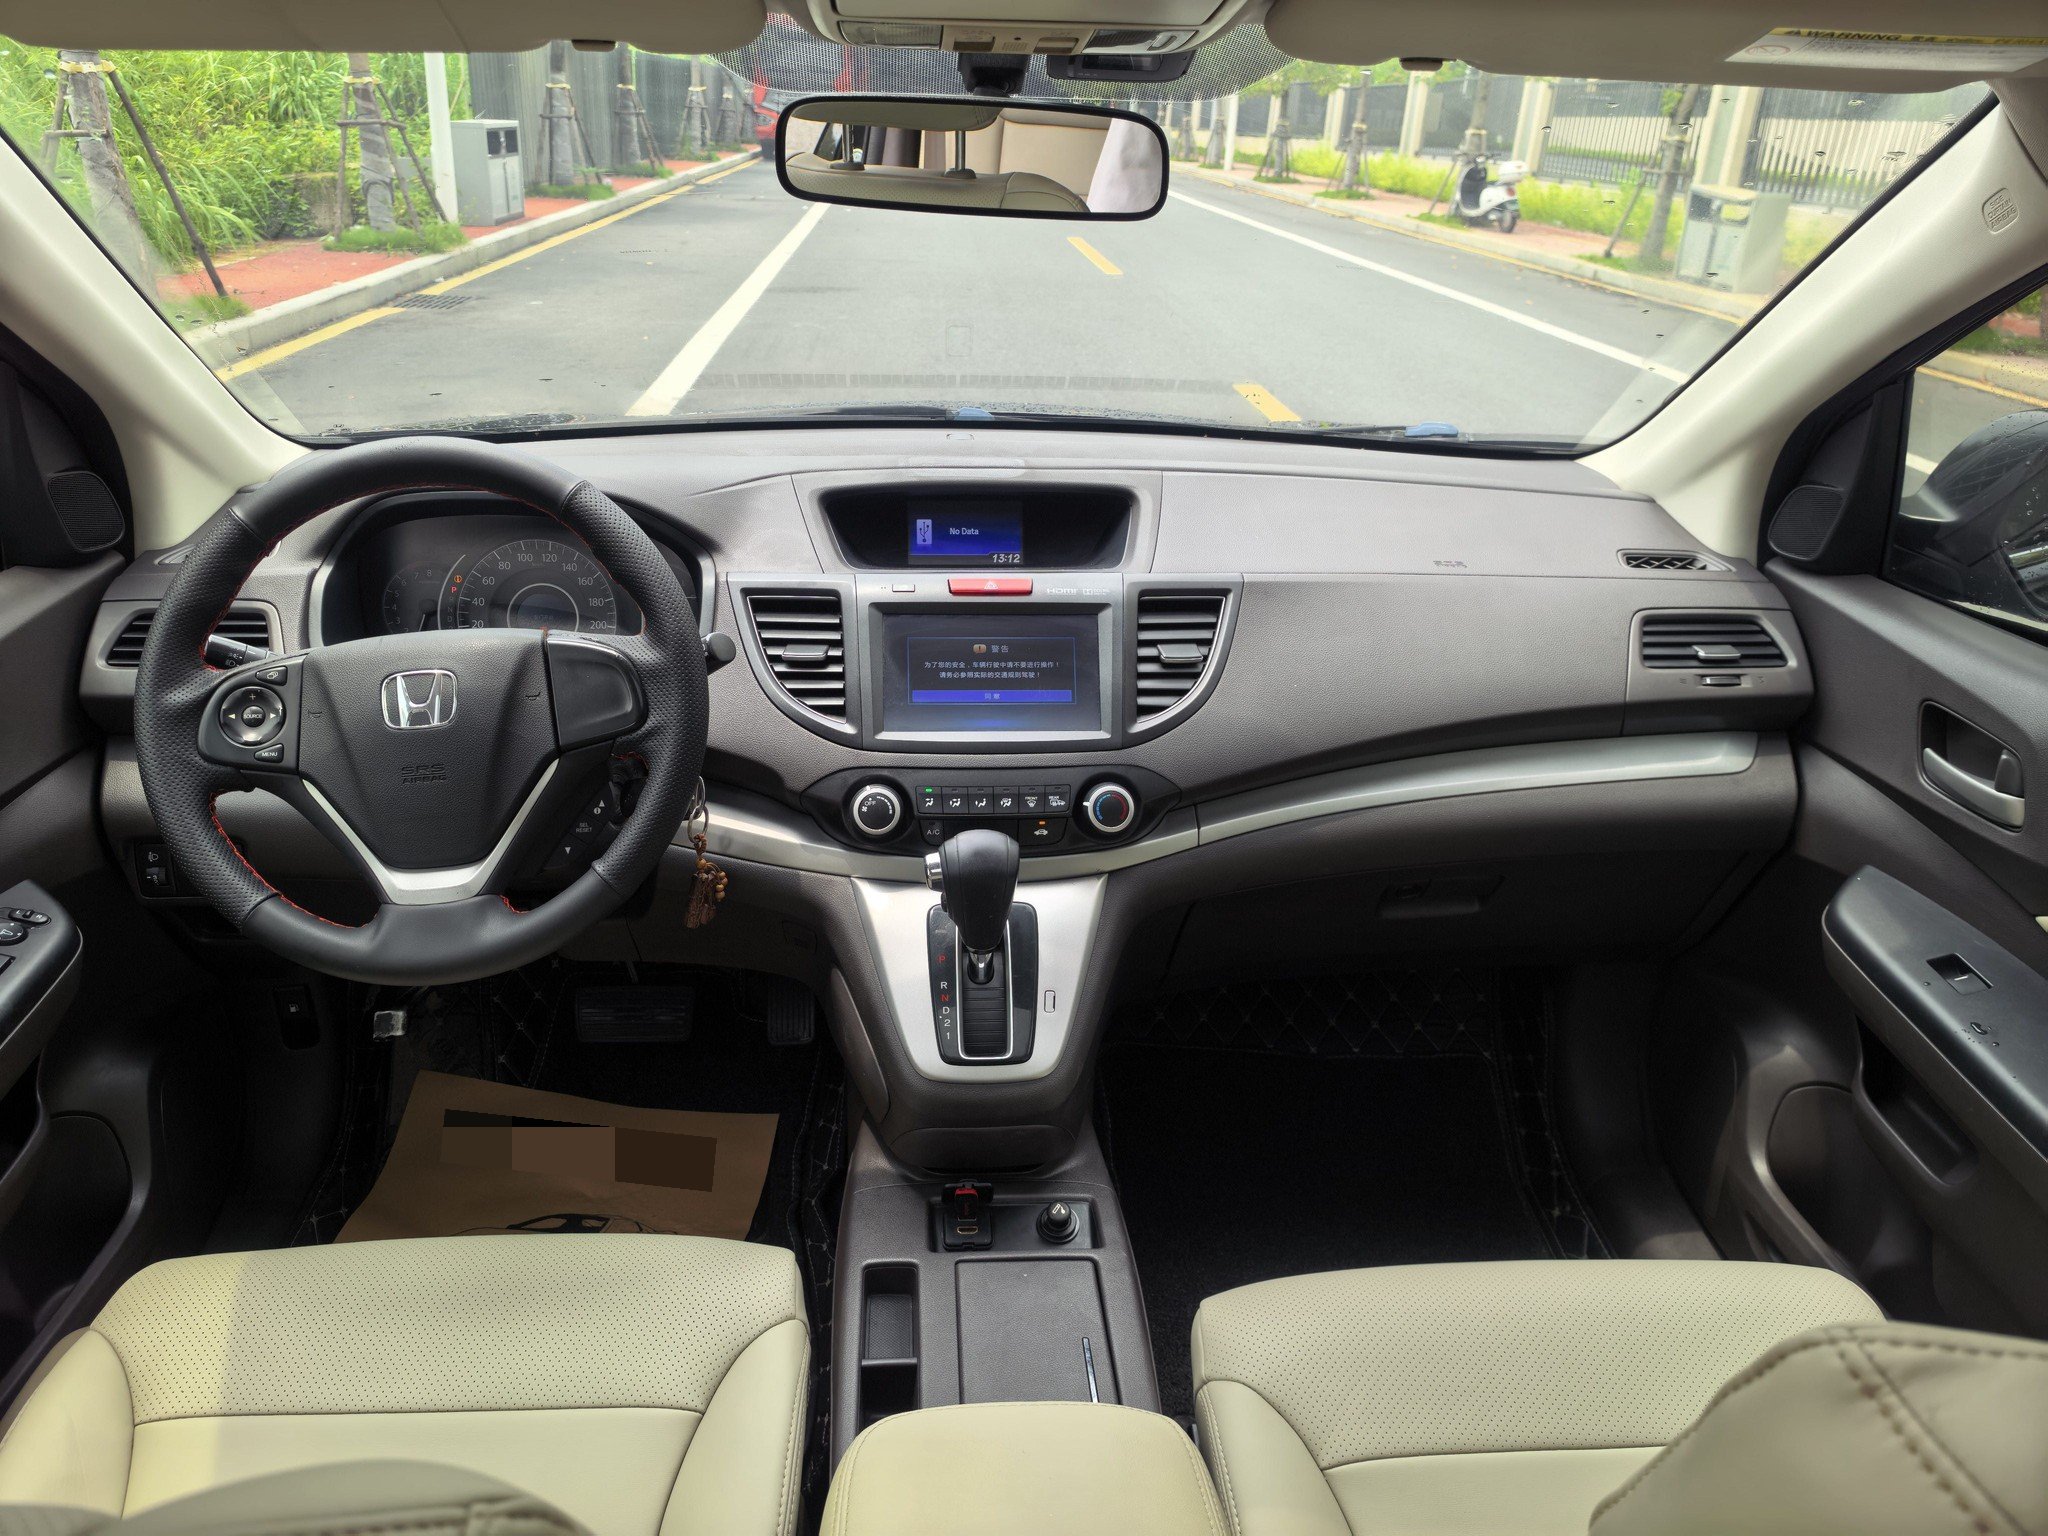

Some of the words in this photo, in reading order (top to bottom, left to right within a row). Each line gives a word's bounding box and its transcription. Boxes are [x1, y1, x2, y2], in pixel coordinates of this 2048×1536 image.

[1806, 30, 1902, 41] WARNING
[949, 527, 960, 536] No
[961, 527, 980, 536] Data
[517, 553, 534, 562] 100
[542, 553, 558, 563] 120
[992, 553, 1021, 564] 13:12
[498, 561, 511, 570] 80
[562, 563, 578, 572] 140
[482, 576, 495, 586] 60
[578, 577, 594, 586] 160
[471, 597, 485, 607] 40
[588, 597, 605, 607] 180
[471, 620, 485, 629] 20
[590, 620, 607, 630] 200
[401, 763, 446, 776] SRS
[940, 981, 948, 990] R
[942, 1006, 950, 1014] D
[944, 1018, 951, 1027] 2
